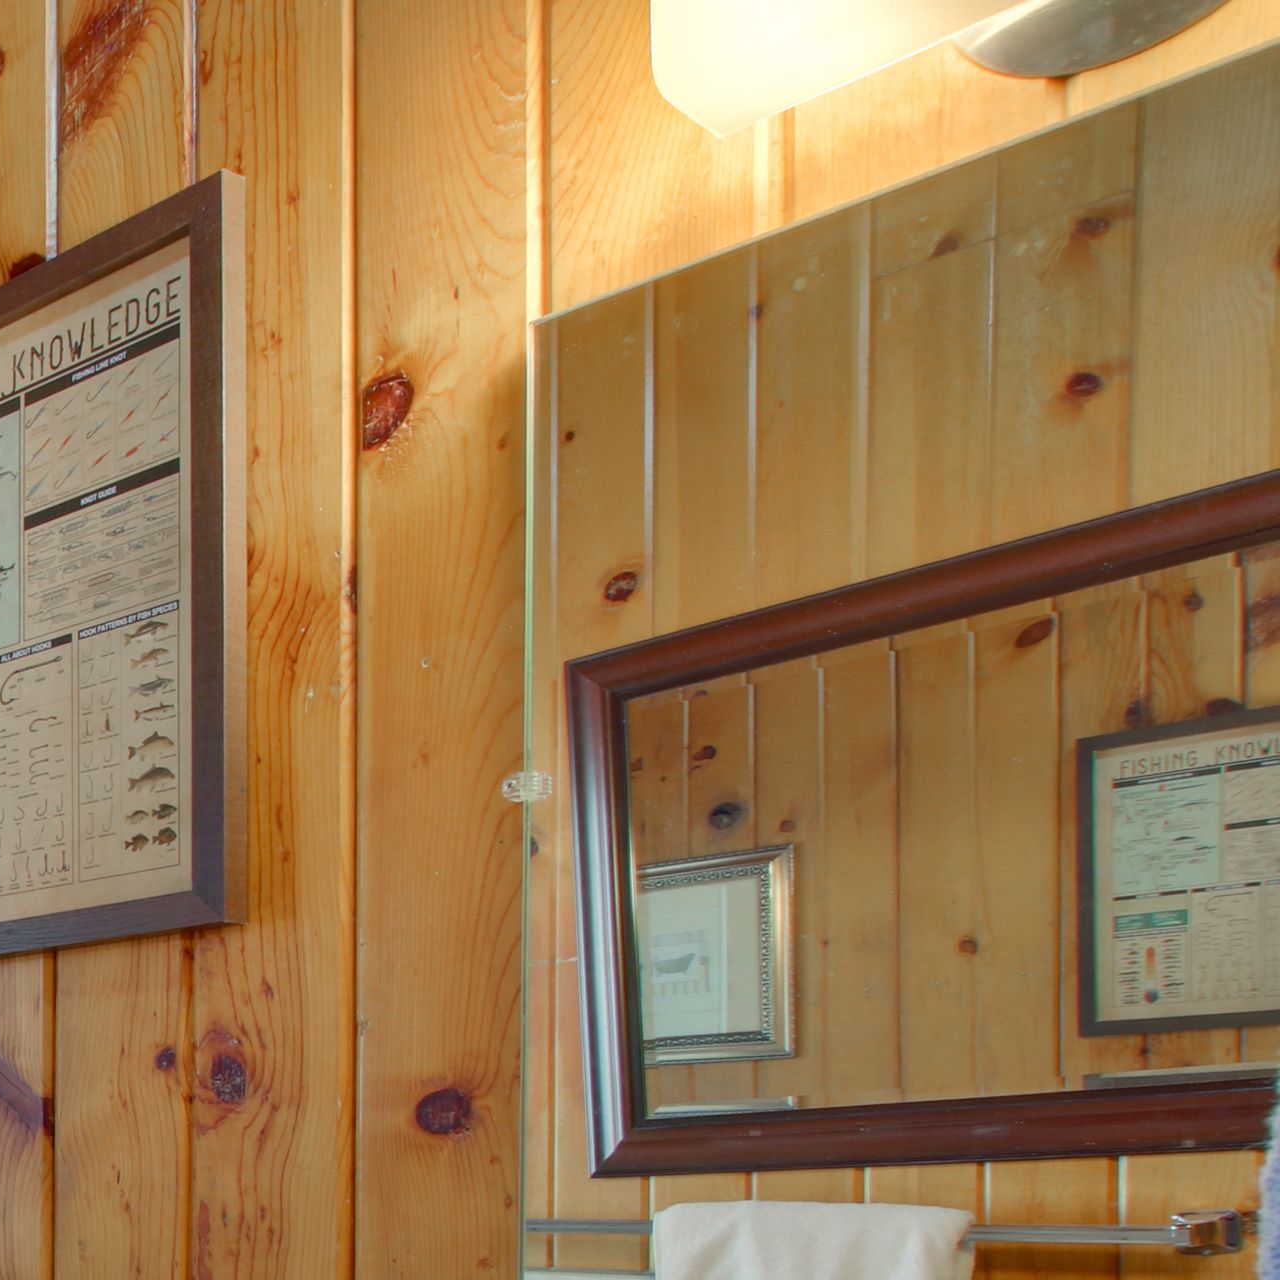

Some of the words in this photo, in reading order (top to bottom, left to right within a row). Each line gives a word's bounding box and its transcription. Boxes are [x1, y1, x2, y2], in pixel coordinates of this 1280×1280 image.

[1, 276, 182, 400] KNOWLEDGE
[72, 367, 95, 382] FISHING
[95, 361, 109, 373] LINE
[109, 351, 128, 367] KNOT
[80, 493, 98, 507] KNOT
[98, 486, 117, 500] GUIDE
[79, 627, 97, 639] HOOK
[137, 609, 152, 621] FISH
[151, 602, 178, 617] SPECIES
[1, 653, 12, 663] ALL
[12, 647, 32, 660] ABOUT
[32, 640, 52, 653] HOOKS
[1112, 750, 1198, 780] FISHING
